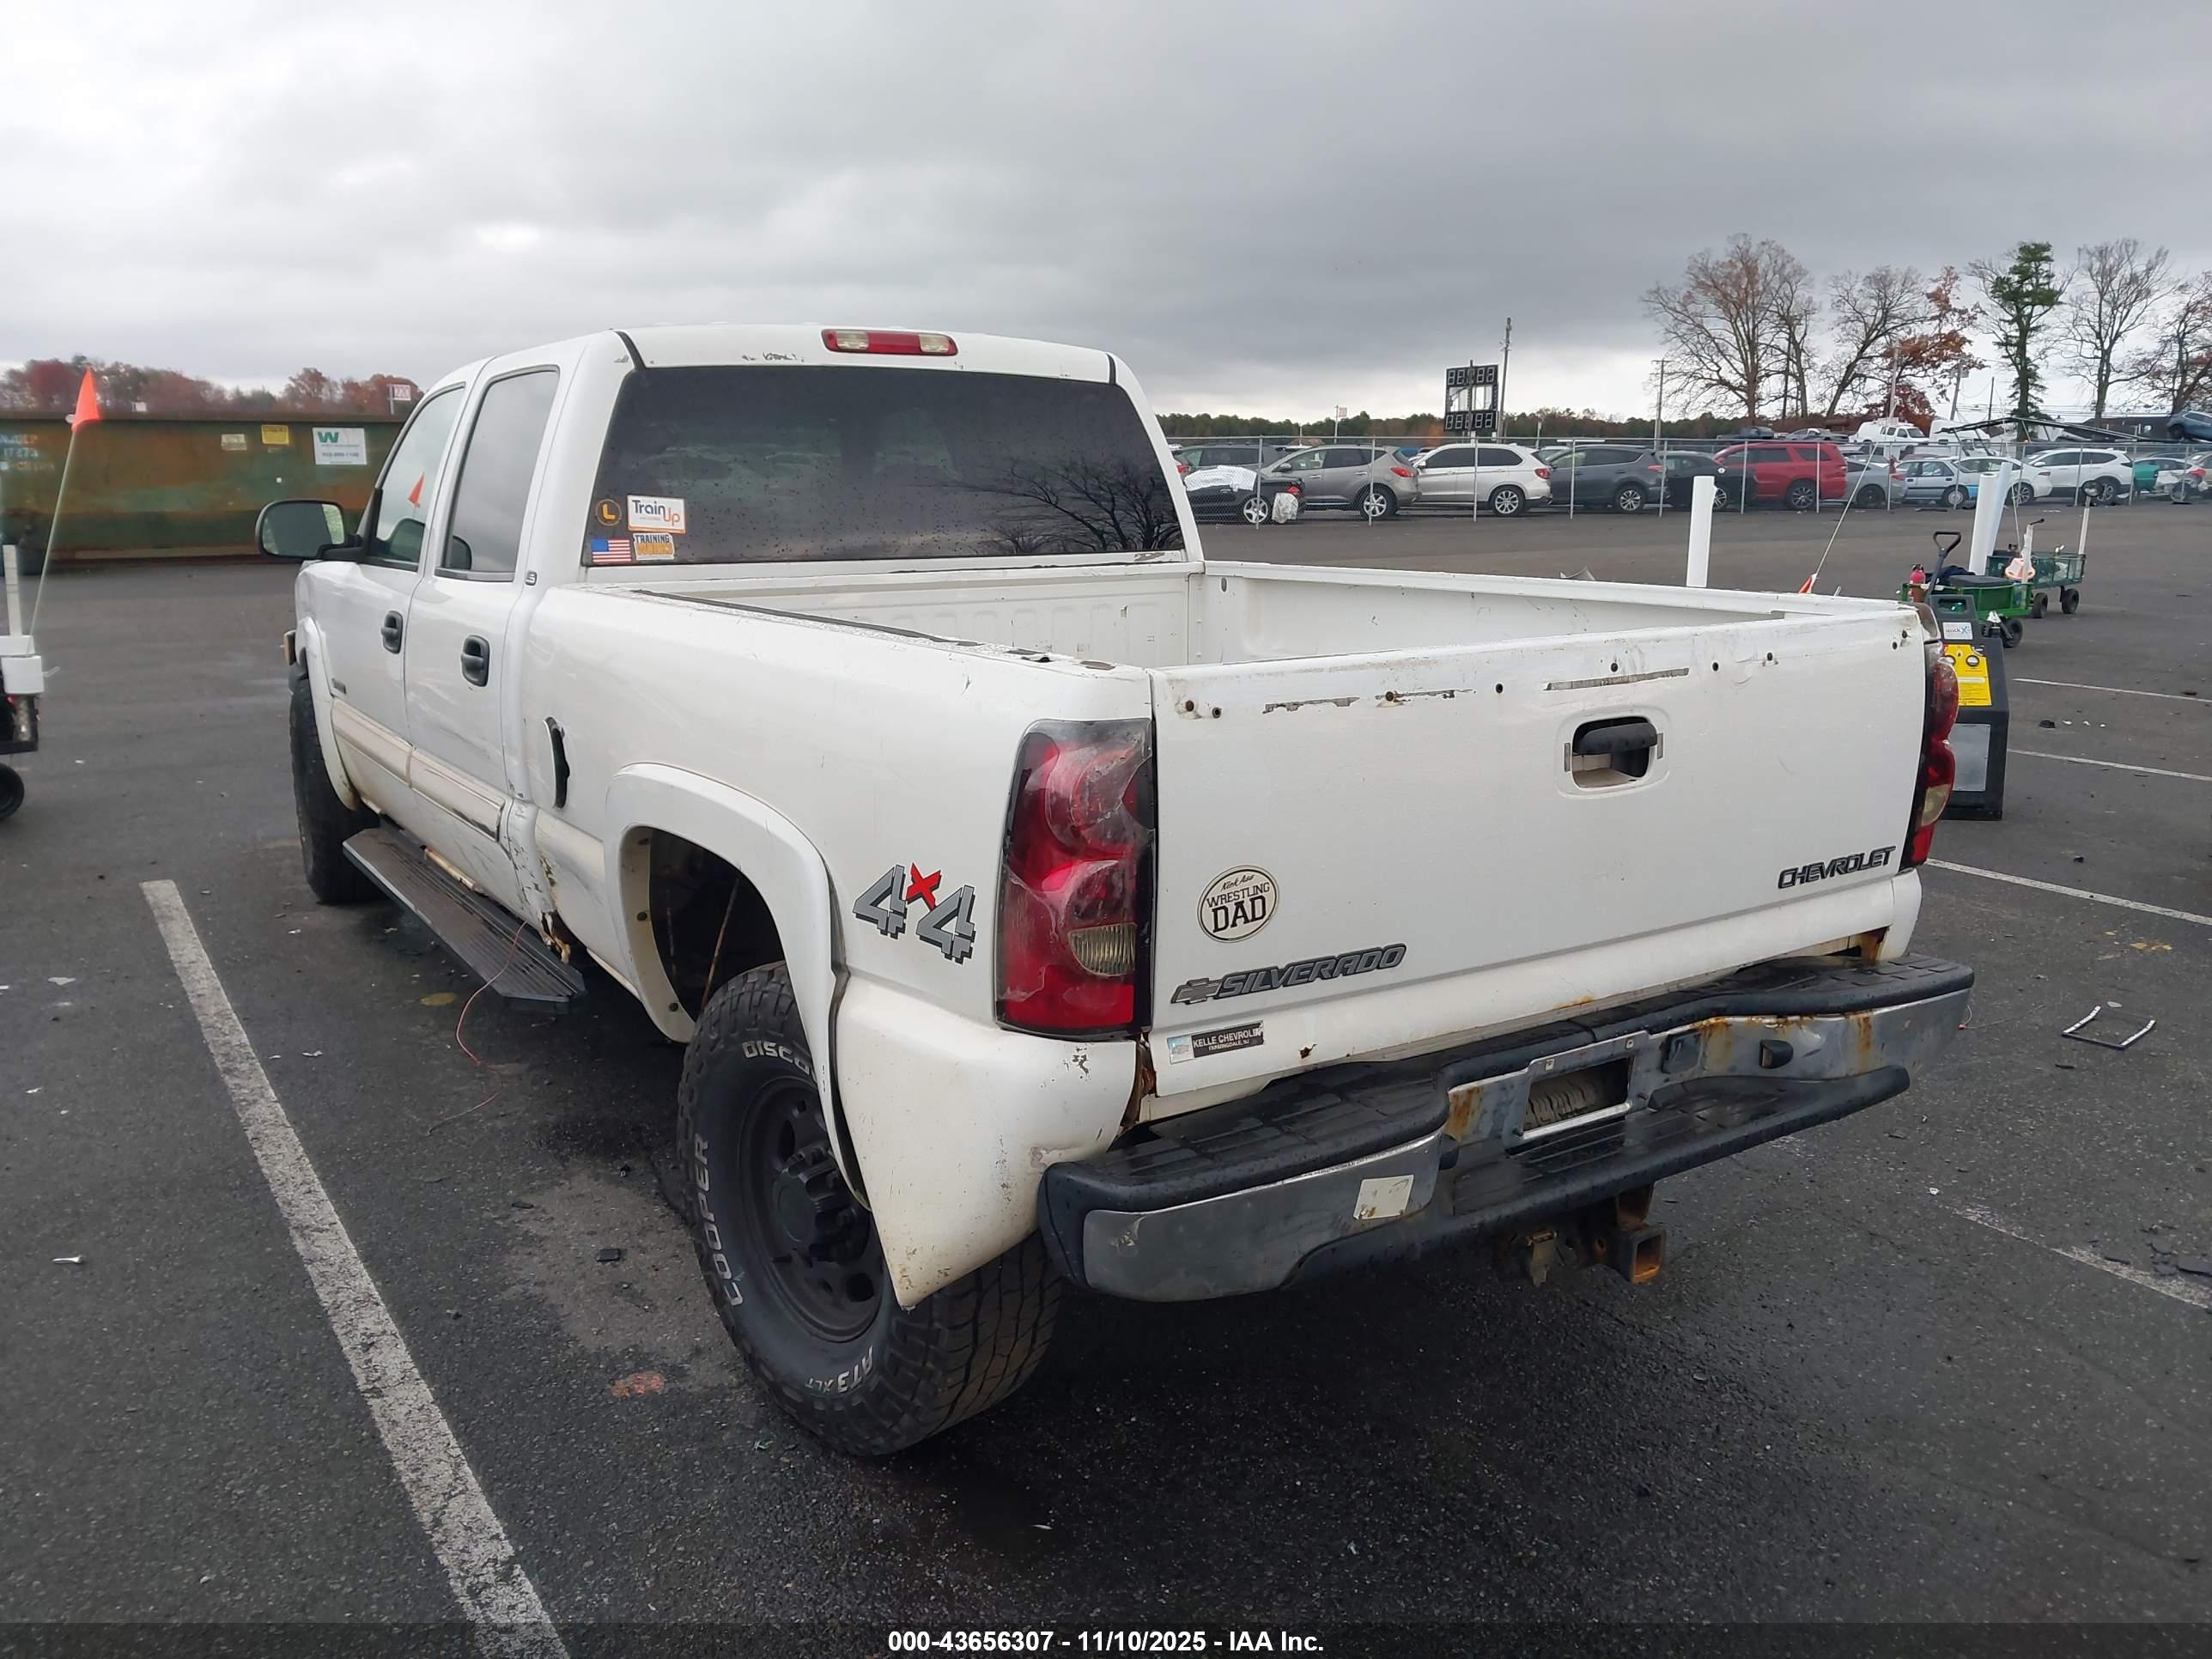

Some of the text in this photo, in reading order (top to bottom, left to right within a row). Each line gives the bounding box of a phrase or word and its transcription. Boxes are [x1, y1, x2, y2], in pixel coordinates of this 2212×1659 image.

[635, 534, 670, 544] TRAINING
[1778, 845, 1897, 890] CHEVROLET
[1206, 881, 1270, 908] WRESTLING
[1212, 895, 1267, 933] DAD
[1212, 943, 1407, 1000] SILVERADO
[1193, 1036, 1218, 1048] KELLE
[694, 1133, 744, 1306] COOPER
[805, 1345, 873, 1394] AT3 XLT
